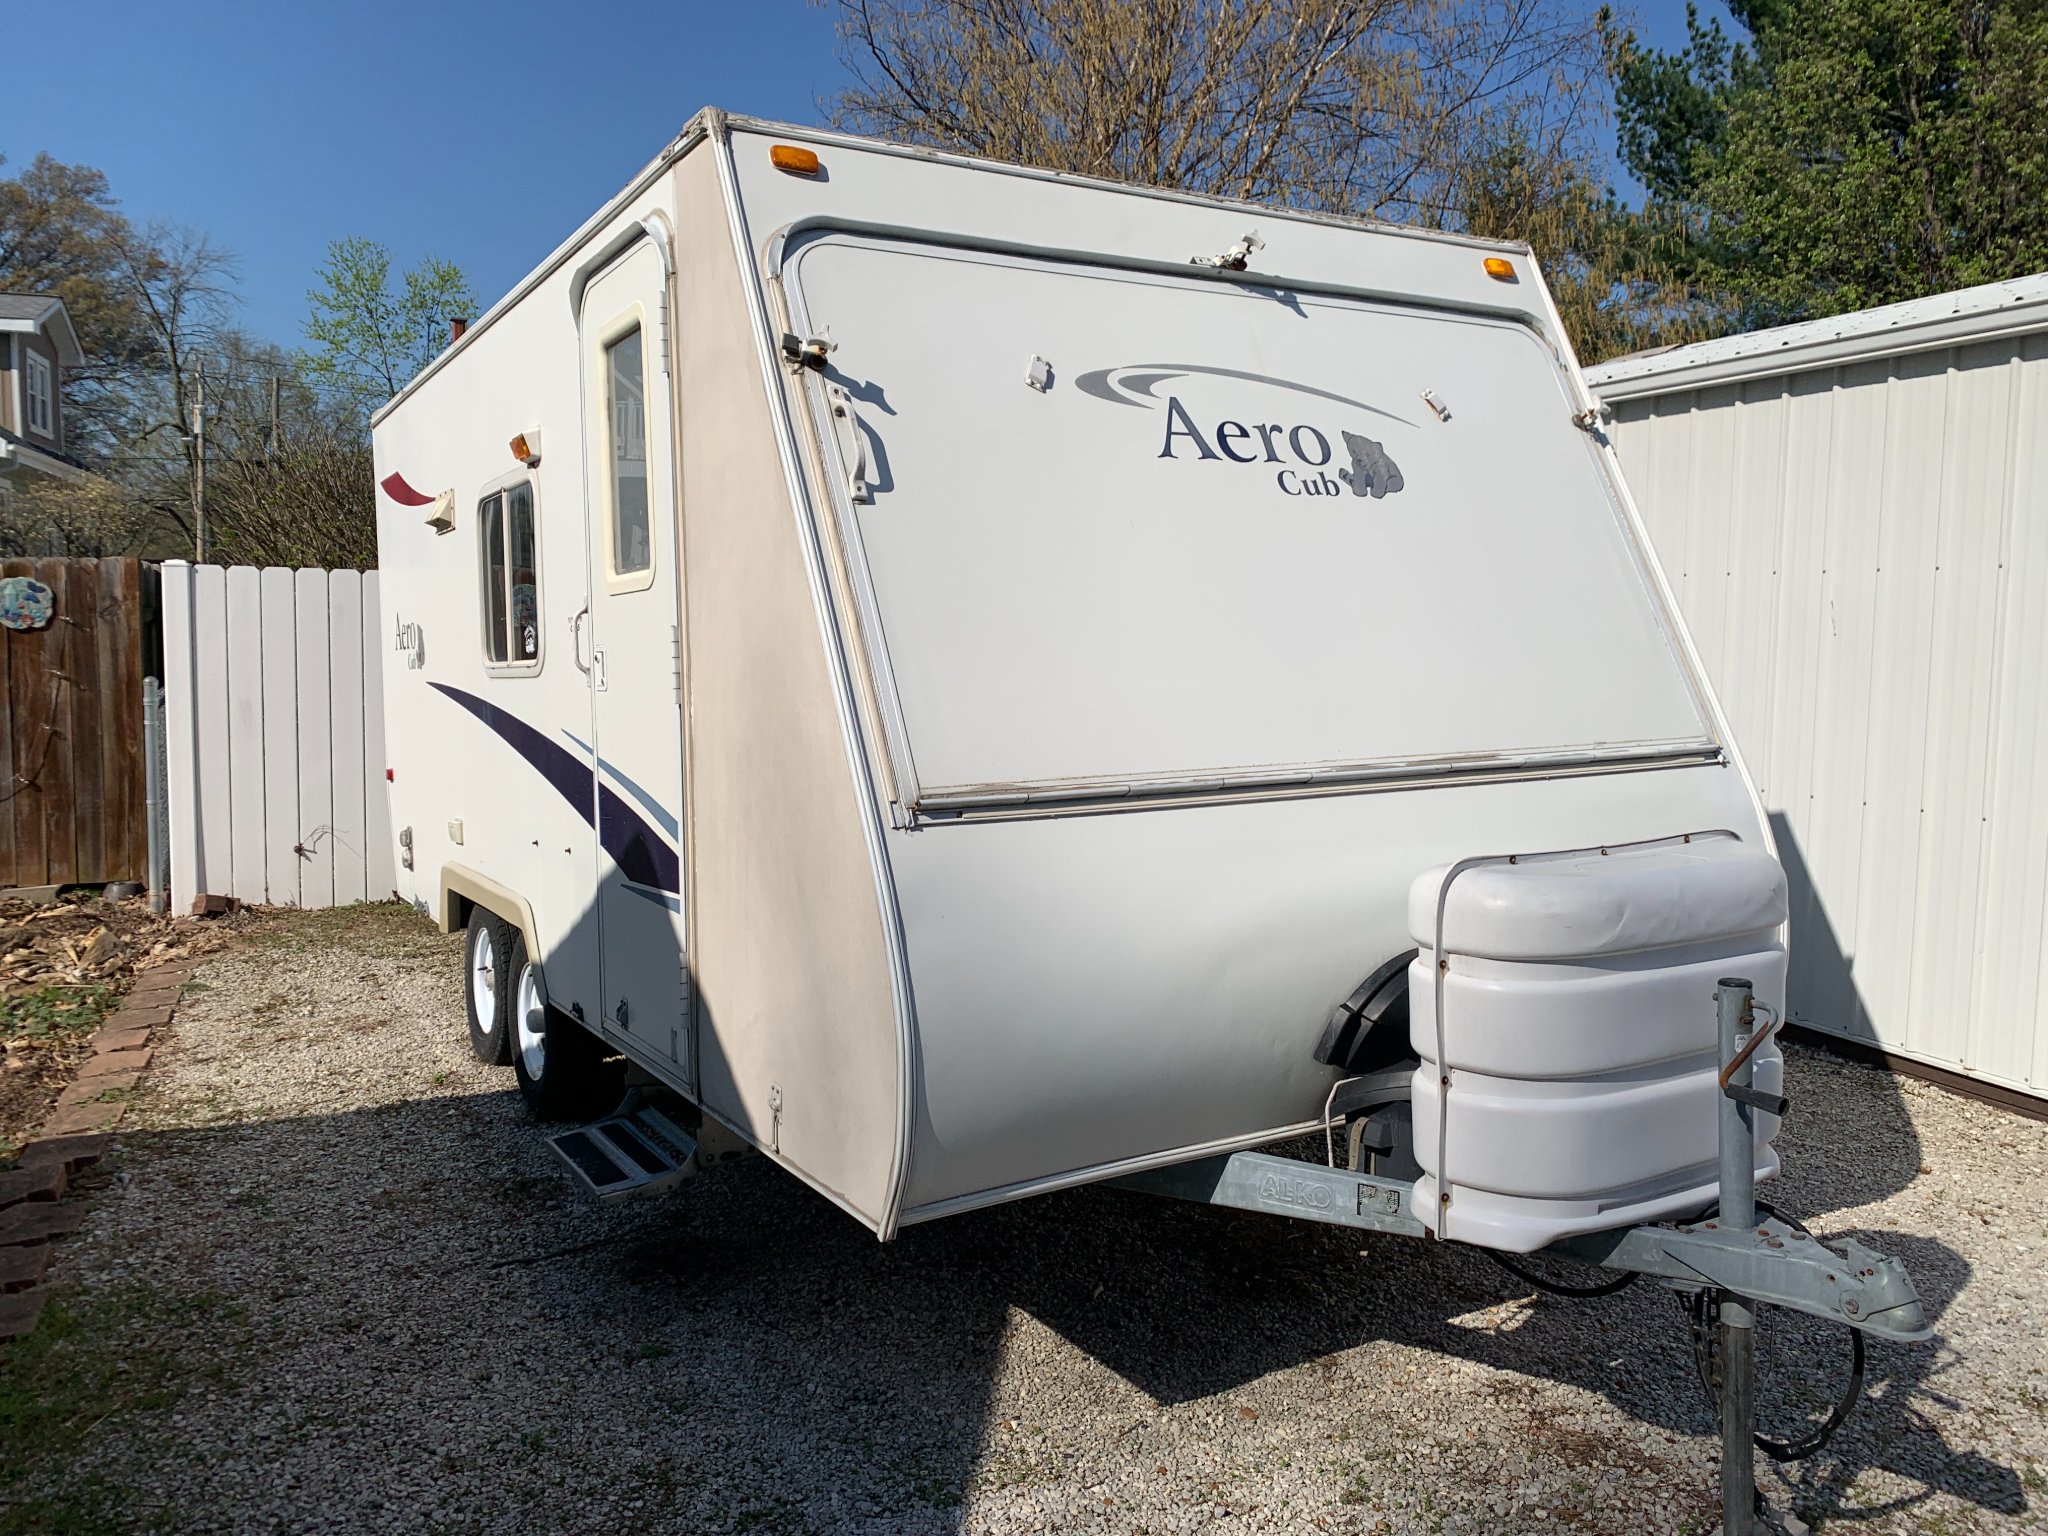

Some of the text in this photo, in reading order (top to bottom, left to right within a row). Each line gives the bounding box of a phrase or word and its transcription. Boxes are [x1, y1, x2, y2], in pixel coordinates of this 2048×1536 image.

[1157, 396, 1332, 466] Aero
[1276, 469, 1341, 497] Cub
[395, 611, 416, 650] Aero
